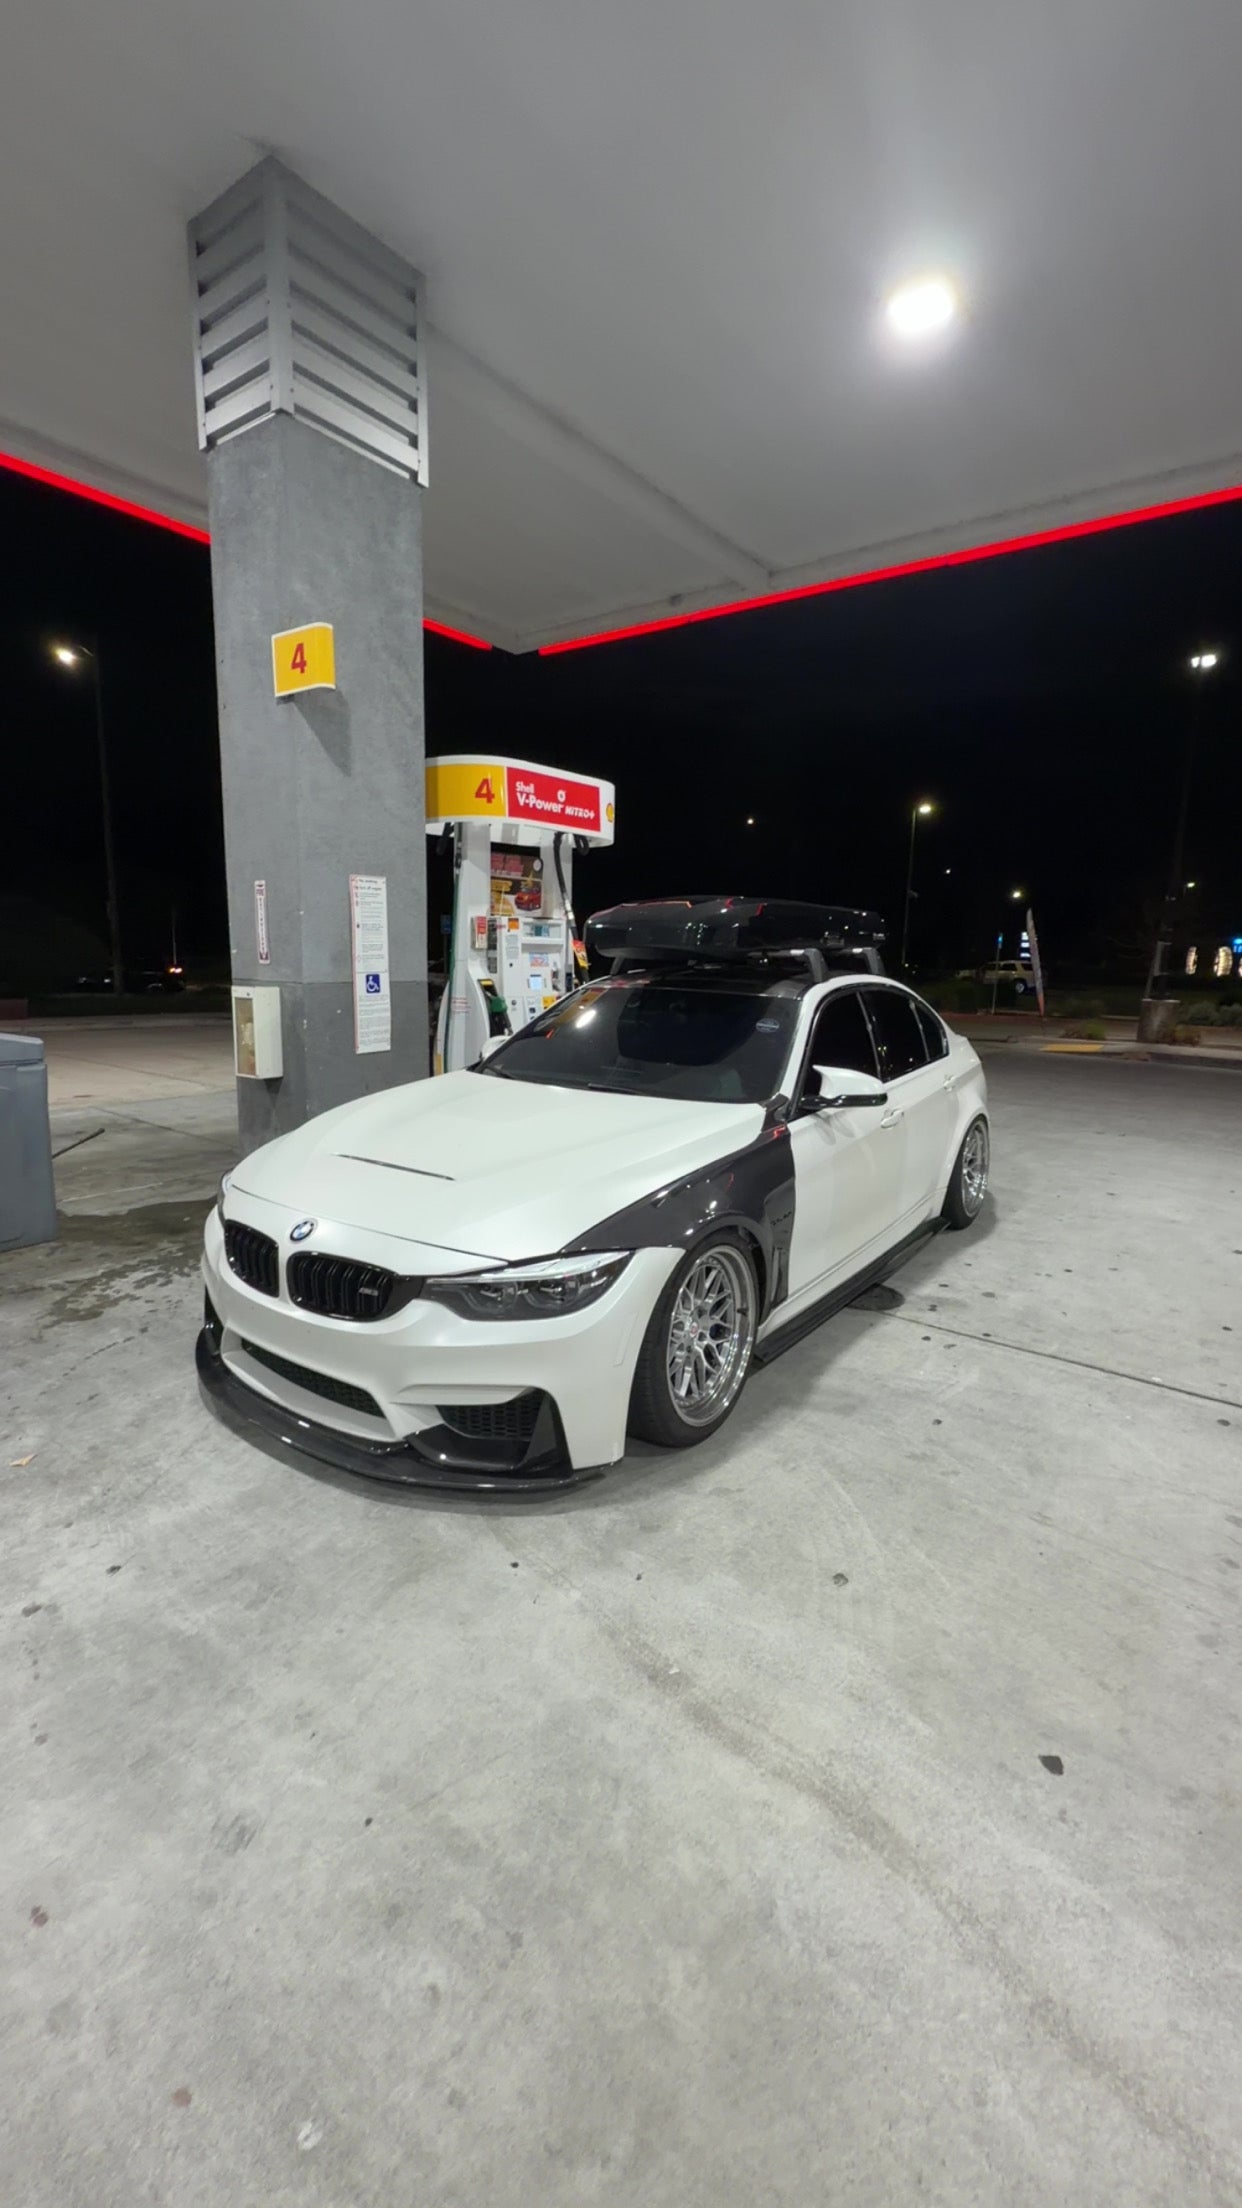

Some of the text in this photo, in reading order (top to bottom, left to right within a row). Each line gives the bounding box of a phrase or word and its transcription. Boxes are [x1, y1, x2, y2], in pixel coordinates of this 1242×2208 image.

[291, 642, 307, 674] 4
[475, 778, 495, 804] 4
[515, 781, 535, 794] Shell
[516, 792, 564, 813] V-Power
